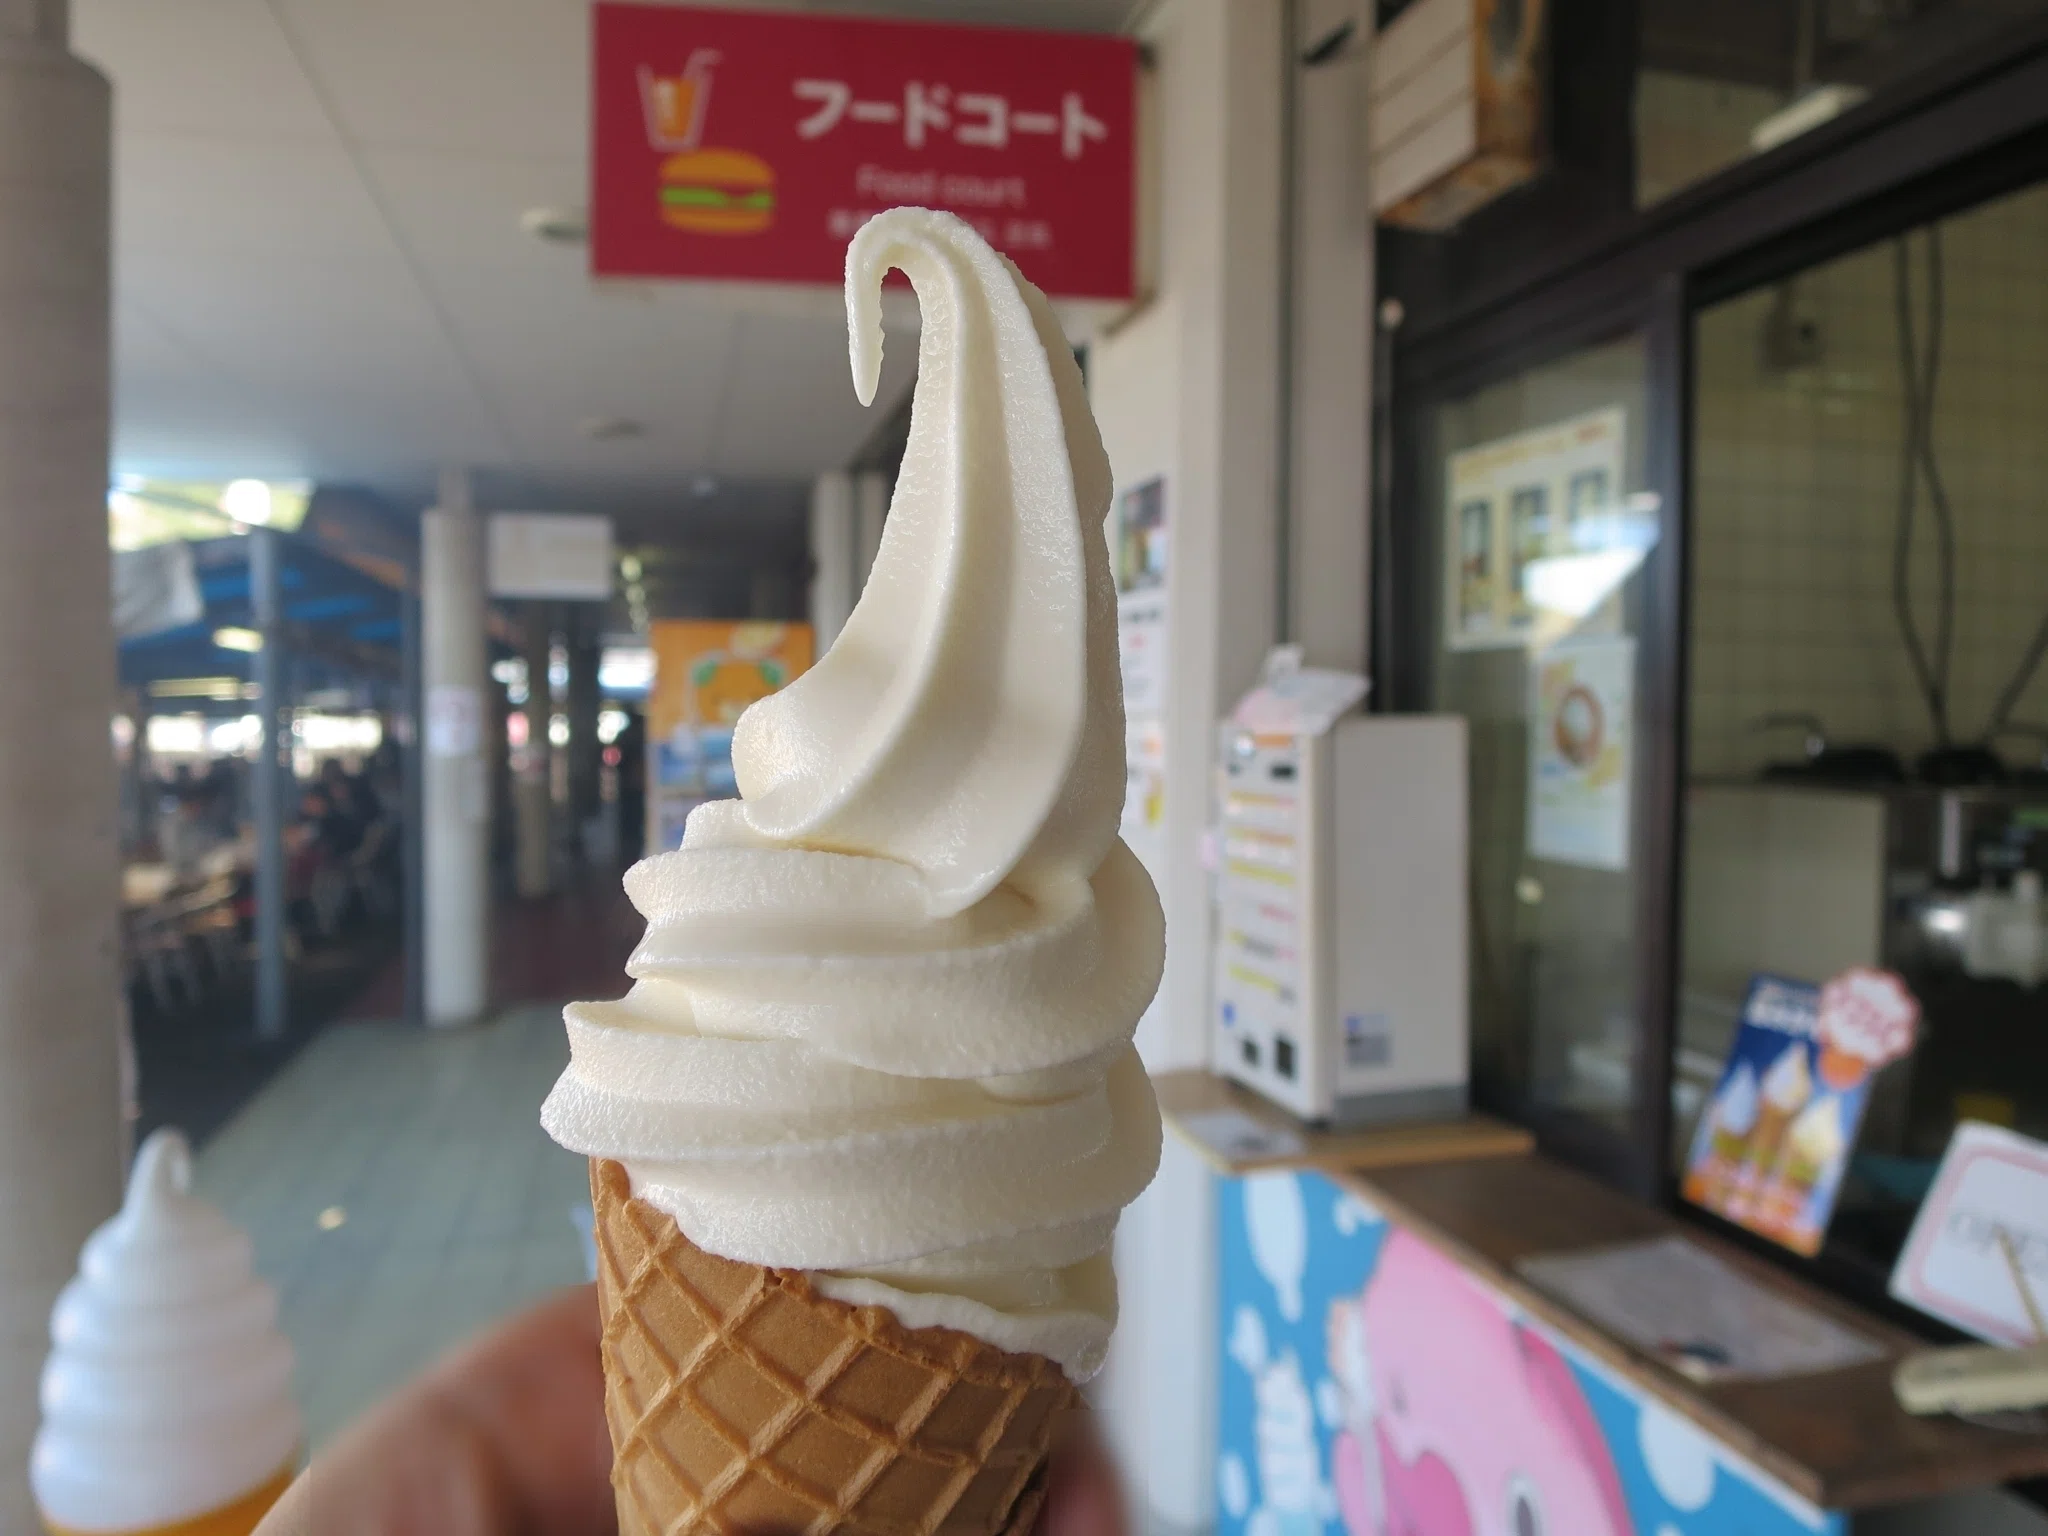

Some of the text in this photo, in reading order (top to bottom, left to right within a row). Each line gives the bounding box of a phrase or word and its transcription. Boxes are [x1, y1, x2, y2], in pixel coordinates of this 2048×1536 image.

[794, 79, 1107, 159] フードコート
[856, 165, 936, 203] Food
